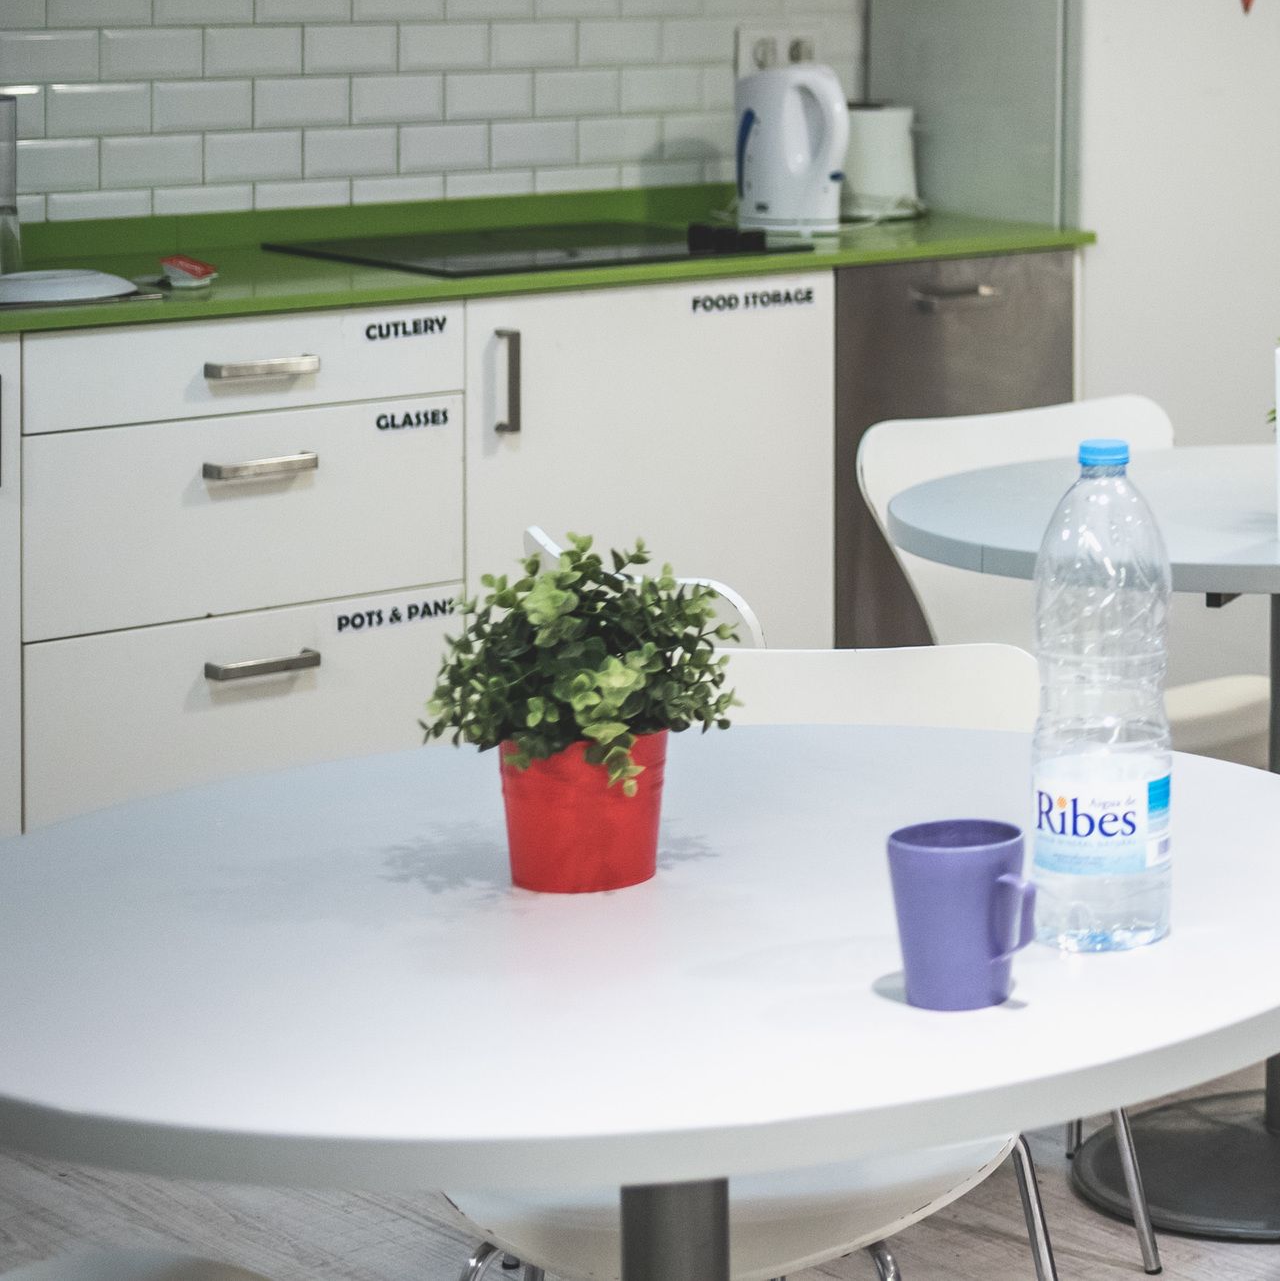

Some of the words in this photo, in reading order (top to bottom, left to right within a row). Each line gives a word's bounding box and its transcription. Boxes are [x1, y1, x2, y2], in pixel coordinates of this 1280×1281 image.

[691, 294, 740, 313] FOOD
[743, 287, 814, 309] STORAGE
[364, 315, 447, 342] CUTLERY
[375, 408, 449, 431] GLASSES
[336, 609, 384, 633] POTS
[388, 606, 403, 625] &
[1036, 790, 1136, 837] Ribes
